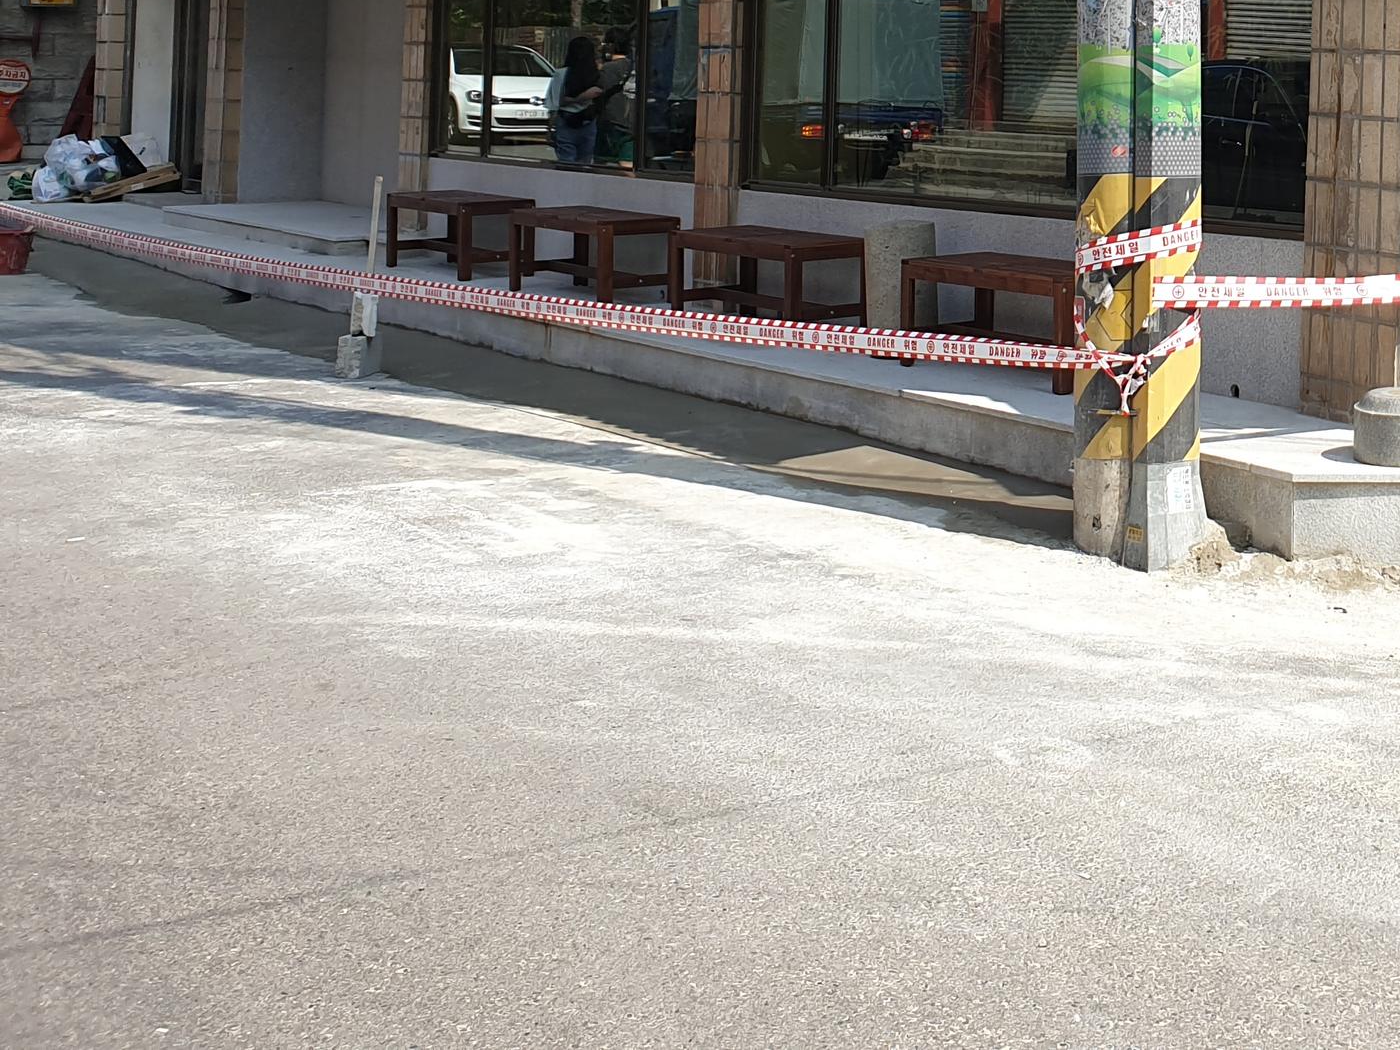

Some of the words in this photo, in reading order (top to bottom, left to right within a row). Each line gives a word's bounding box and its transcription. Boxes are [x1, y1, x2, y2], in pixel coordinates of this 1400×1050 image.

[1092, 241, 1139, 261] 안전제일
[759, 327, 784, 339] DANGER
[827, 333, 855, 346] 안전제일
[867, 336, 895, 349] DANGER
[904, 339, 918, 351] 위험
[943, 342, 975, 356] 안전제일
[989, 346, 1021, 358] DANGER
